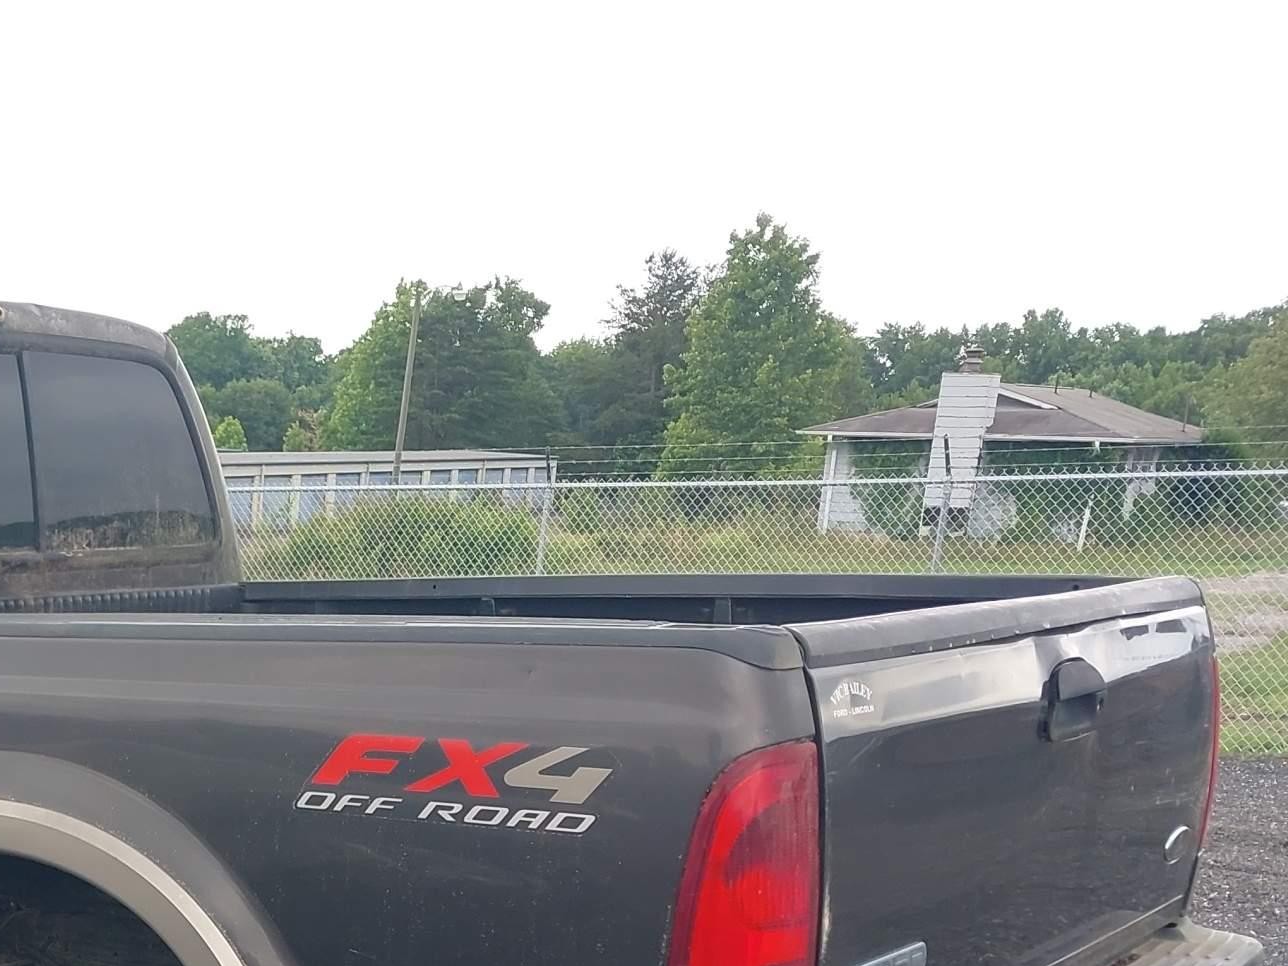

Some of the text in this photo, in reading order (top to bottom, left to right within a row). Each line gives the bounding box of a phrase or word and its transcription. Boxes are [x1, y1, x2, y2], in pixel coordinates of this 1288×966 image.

[843, 681, 873, 700] BAILEY
[309, 732, 614, 805] FX4
[294, 790, 598, 835] OFF ROAD
